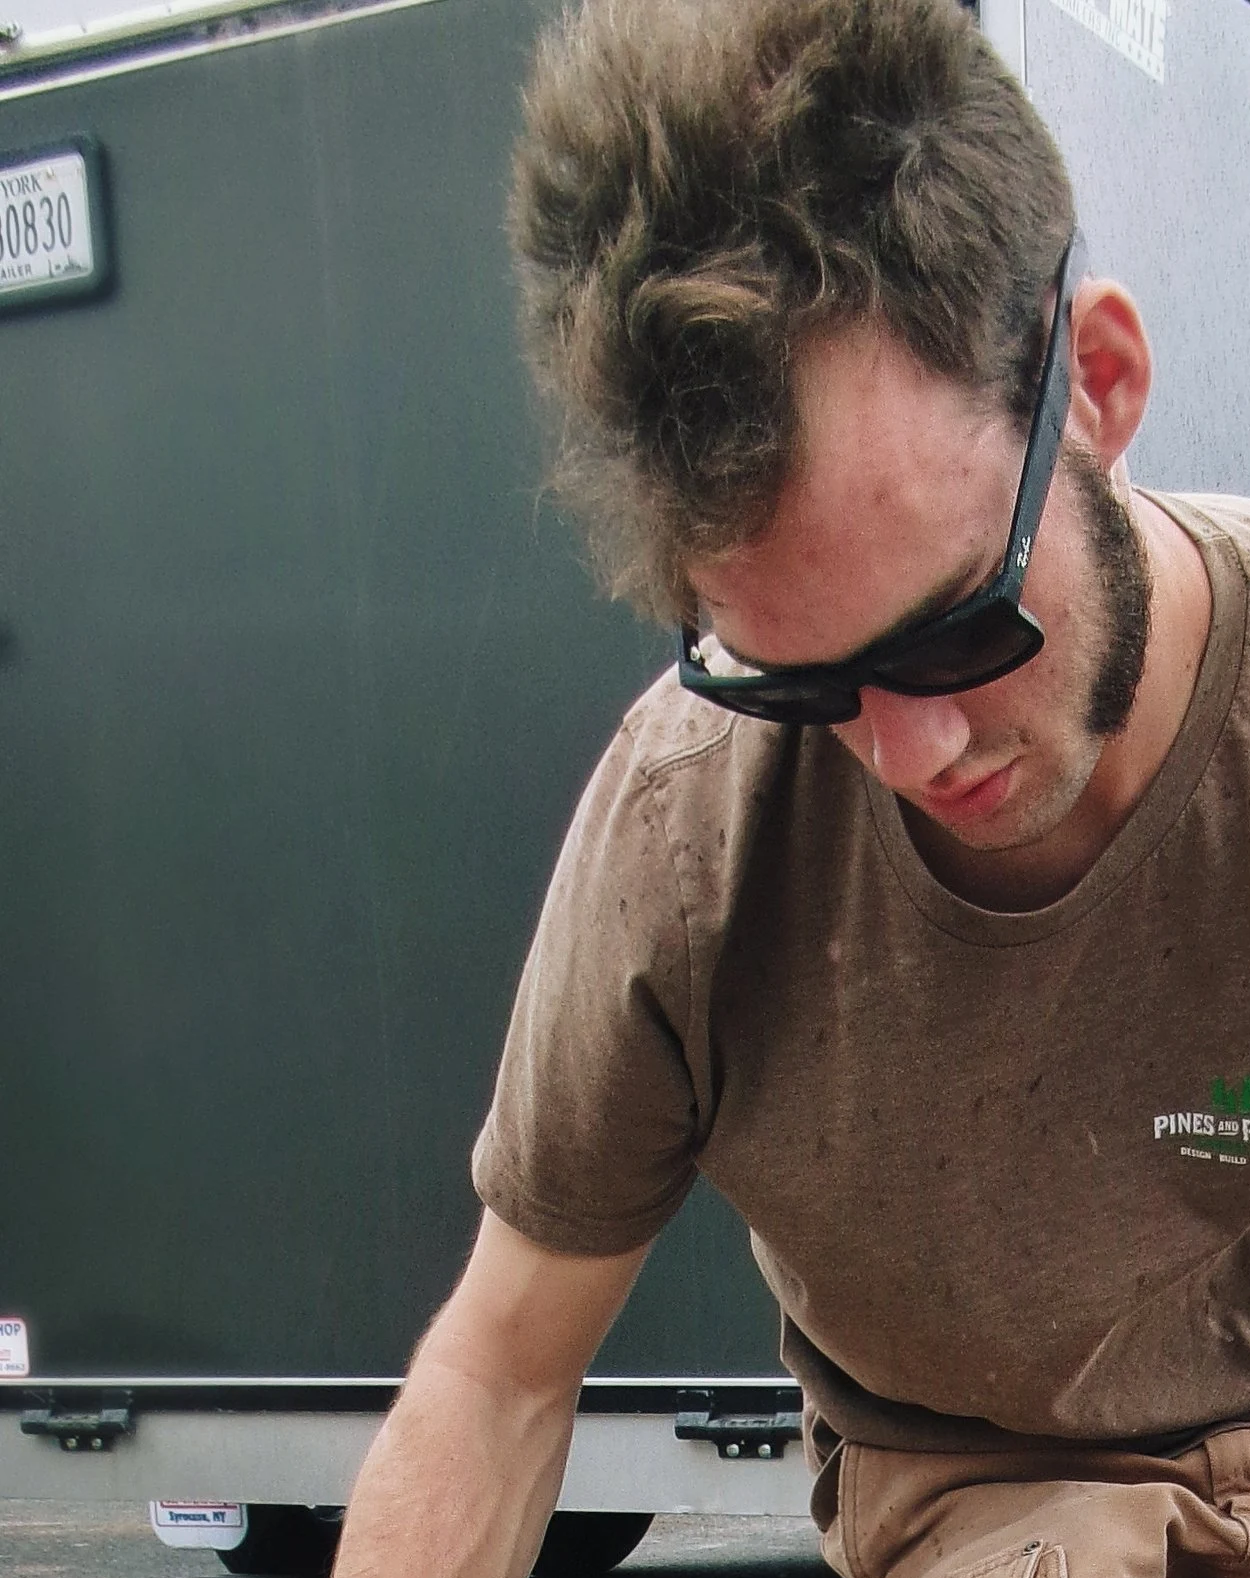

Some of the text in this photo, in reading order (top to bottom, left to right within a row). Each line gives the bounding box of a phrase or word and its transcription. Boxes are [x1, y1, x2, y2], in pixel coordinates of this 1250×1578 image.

[1, 174, 42, 199] YORK
[1153, 1112, 1215, 1139] PINES
[1218, 1120, 1239, 1135] AND
[1180, 1146, 1212, 1160] DESIGN
[1219, 1153, 1247, 1165] BUILD
[212, 1511, 226, 1523] NY
